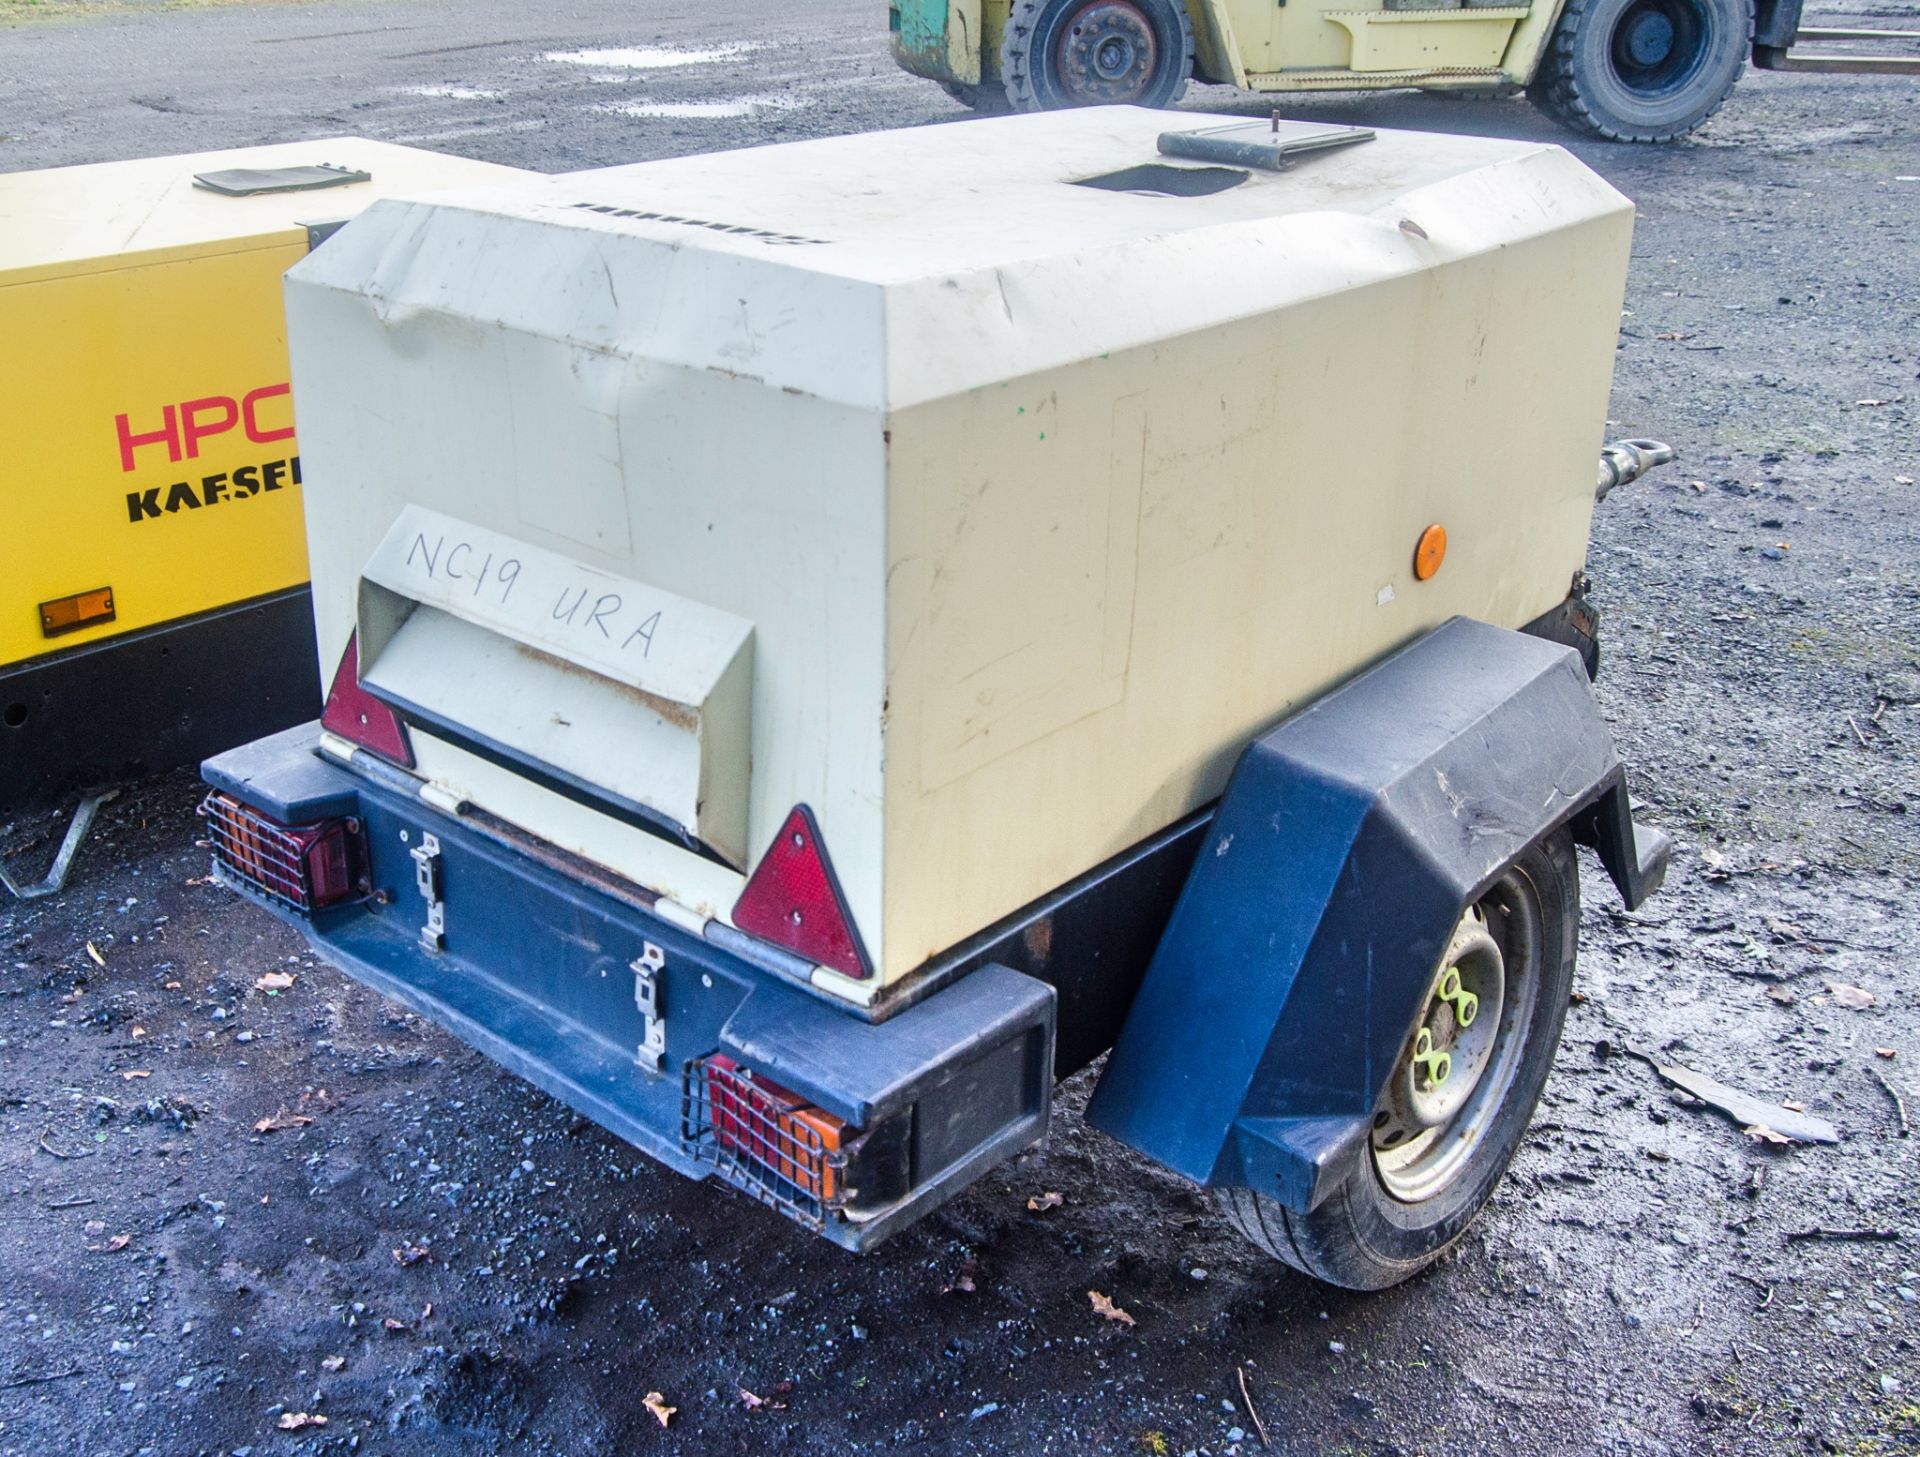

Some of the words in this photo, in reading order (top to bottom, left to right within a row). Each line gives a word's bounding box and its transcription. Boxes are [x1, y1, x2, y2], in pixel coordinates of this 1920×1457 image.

[115, 383, 295, 472] HPC
[406, 533, 521, 603] NC19
[552, 587, 661, 658] URA
